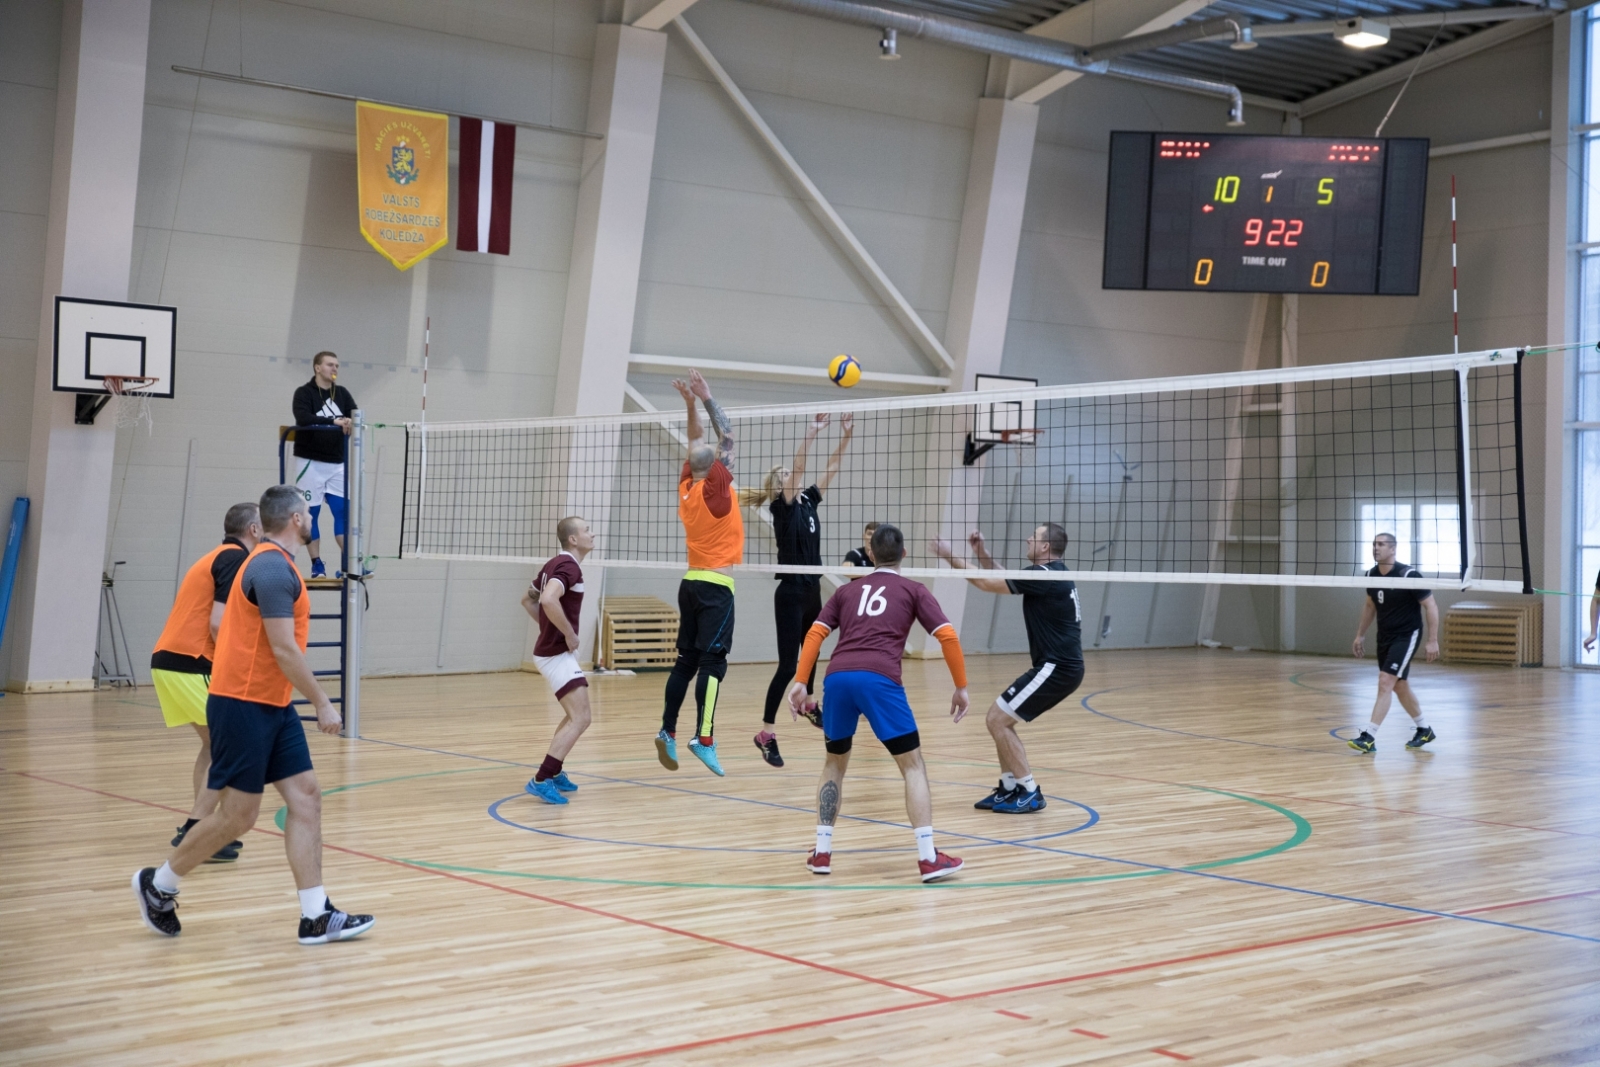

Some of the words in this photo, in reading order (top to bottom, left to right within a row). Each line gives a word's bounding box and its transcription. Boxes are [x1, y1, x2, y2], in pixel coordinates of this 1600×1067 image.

[383, 194, 420, 208] VALSTS
[1214, 176, 1240, 203] 10
[1266, 186, 1274, 202] 1
[1316, 178, 1334, 205] 5
[1194, 259, 1213, 285] 0
[1242, 256, 1265, 266] TIME
[1268, 257, 1287, 267] OUT
[1310, 261, 1330, 287] 0
[809, 516, 816, 534] 3
[858, 585, 887, 616] 16
[1378, 590, 1384, 604] 9
